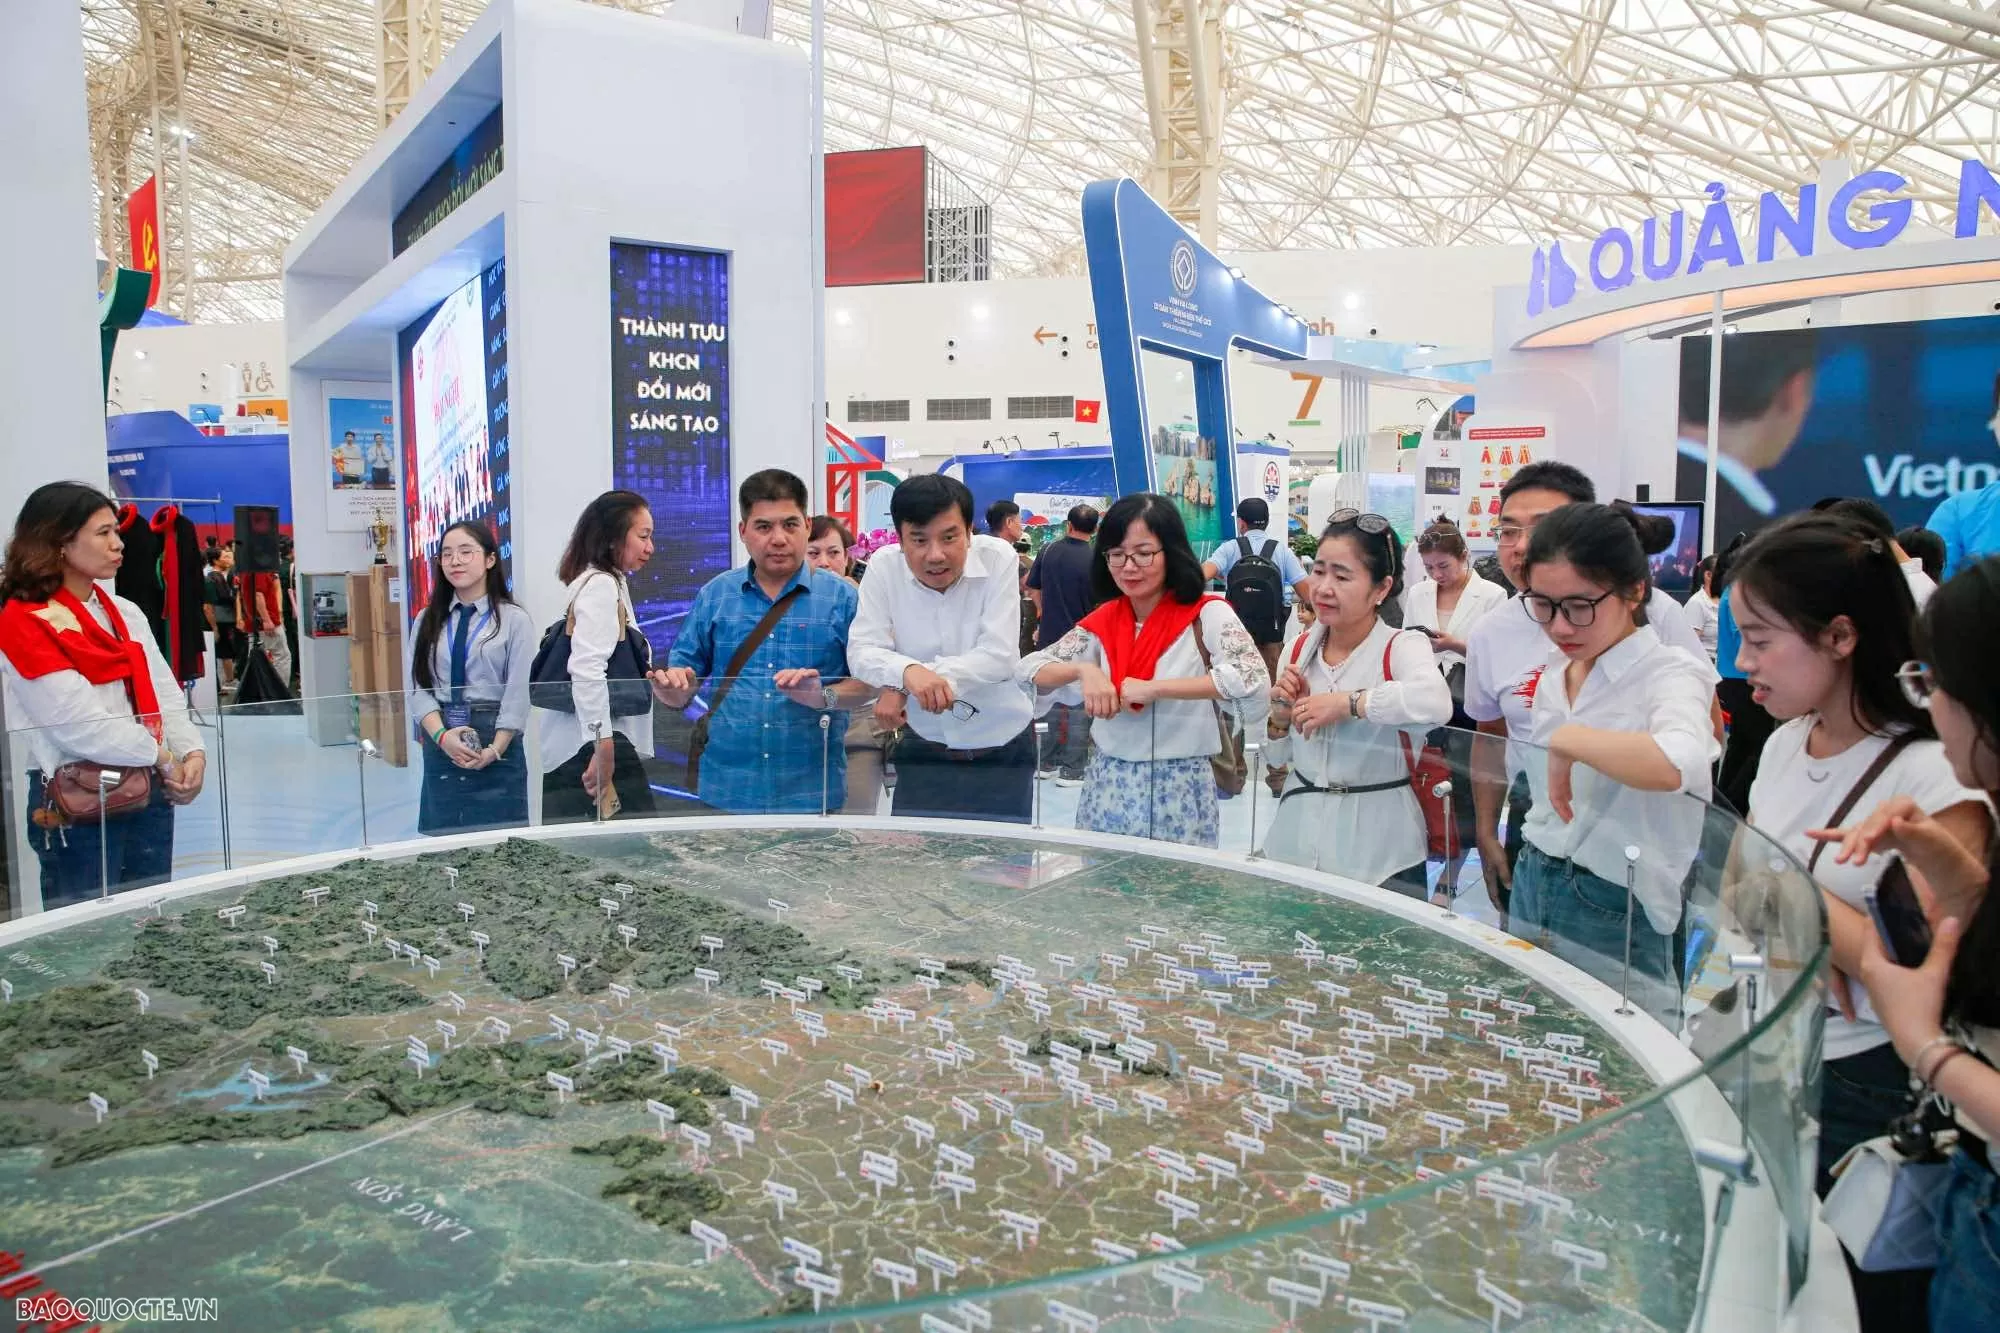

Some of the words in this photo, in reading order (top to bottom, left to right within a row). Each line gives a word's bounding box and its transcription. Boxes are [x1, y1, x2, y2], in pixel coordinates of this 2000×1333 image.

[1589, 170, 1912, 292] QUẢNG
[620, 315, 685, 339] THÀNH
[689, 322, 725, 343] TỰU
[648, 351, 700, 370] KHCN
[637, 375, 671, 399] ĐỔI
[675, 381, 711, 401] MỚI
[1290, 371, 1323, 420] 7
[629, 409, 678, 431] SÁNG
[681, 415, 719, 434] TẠO
